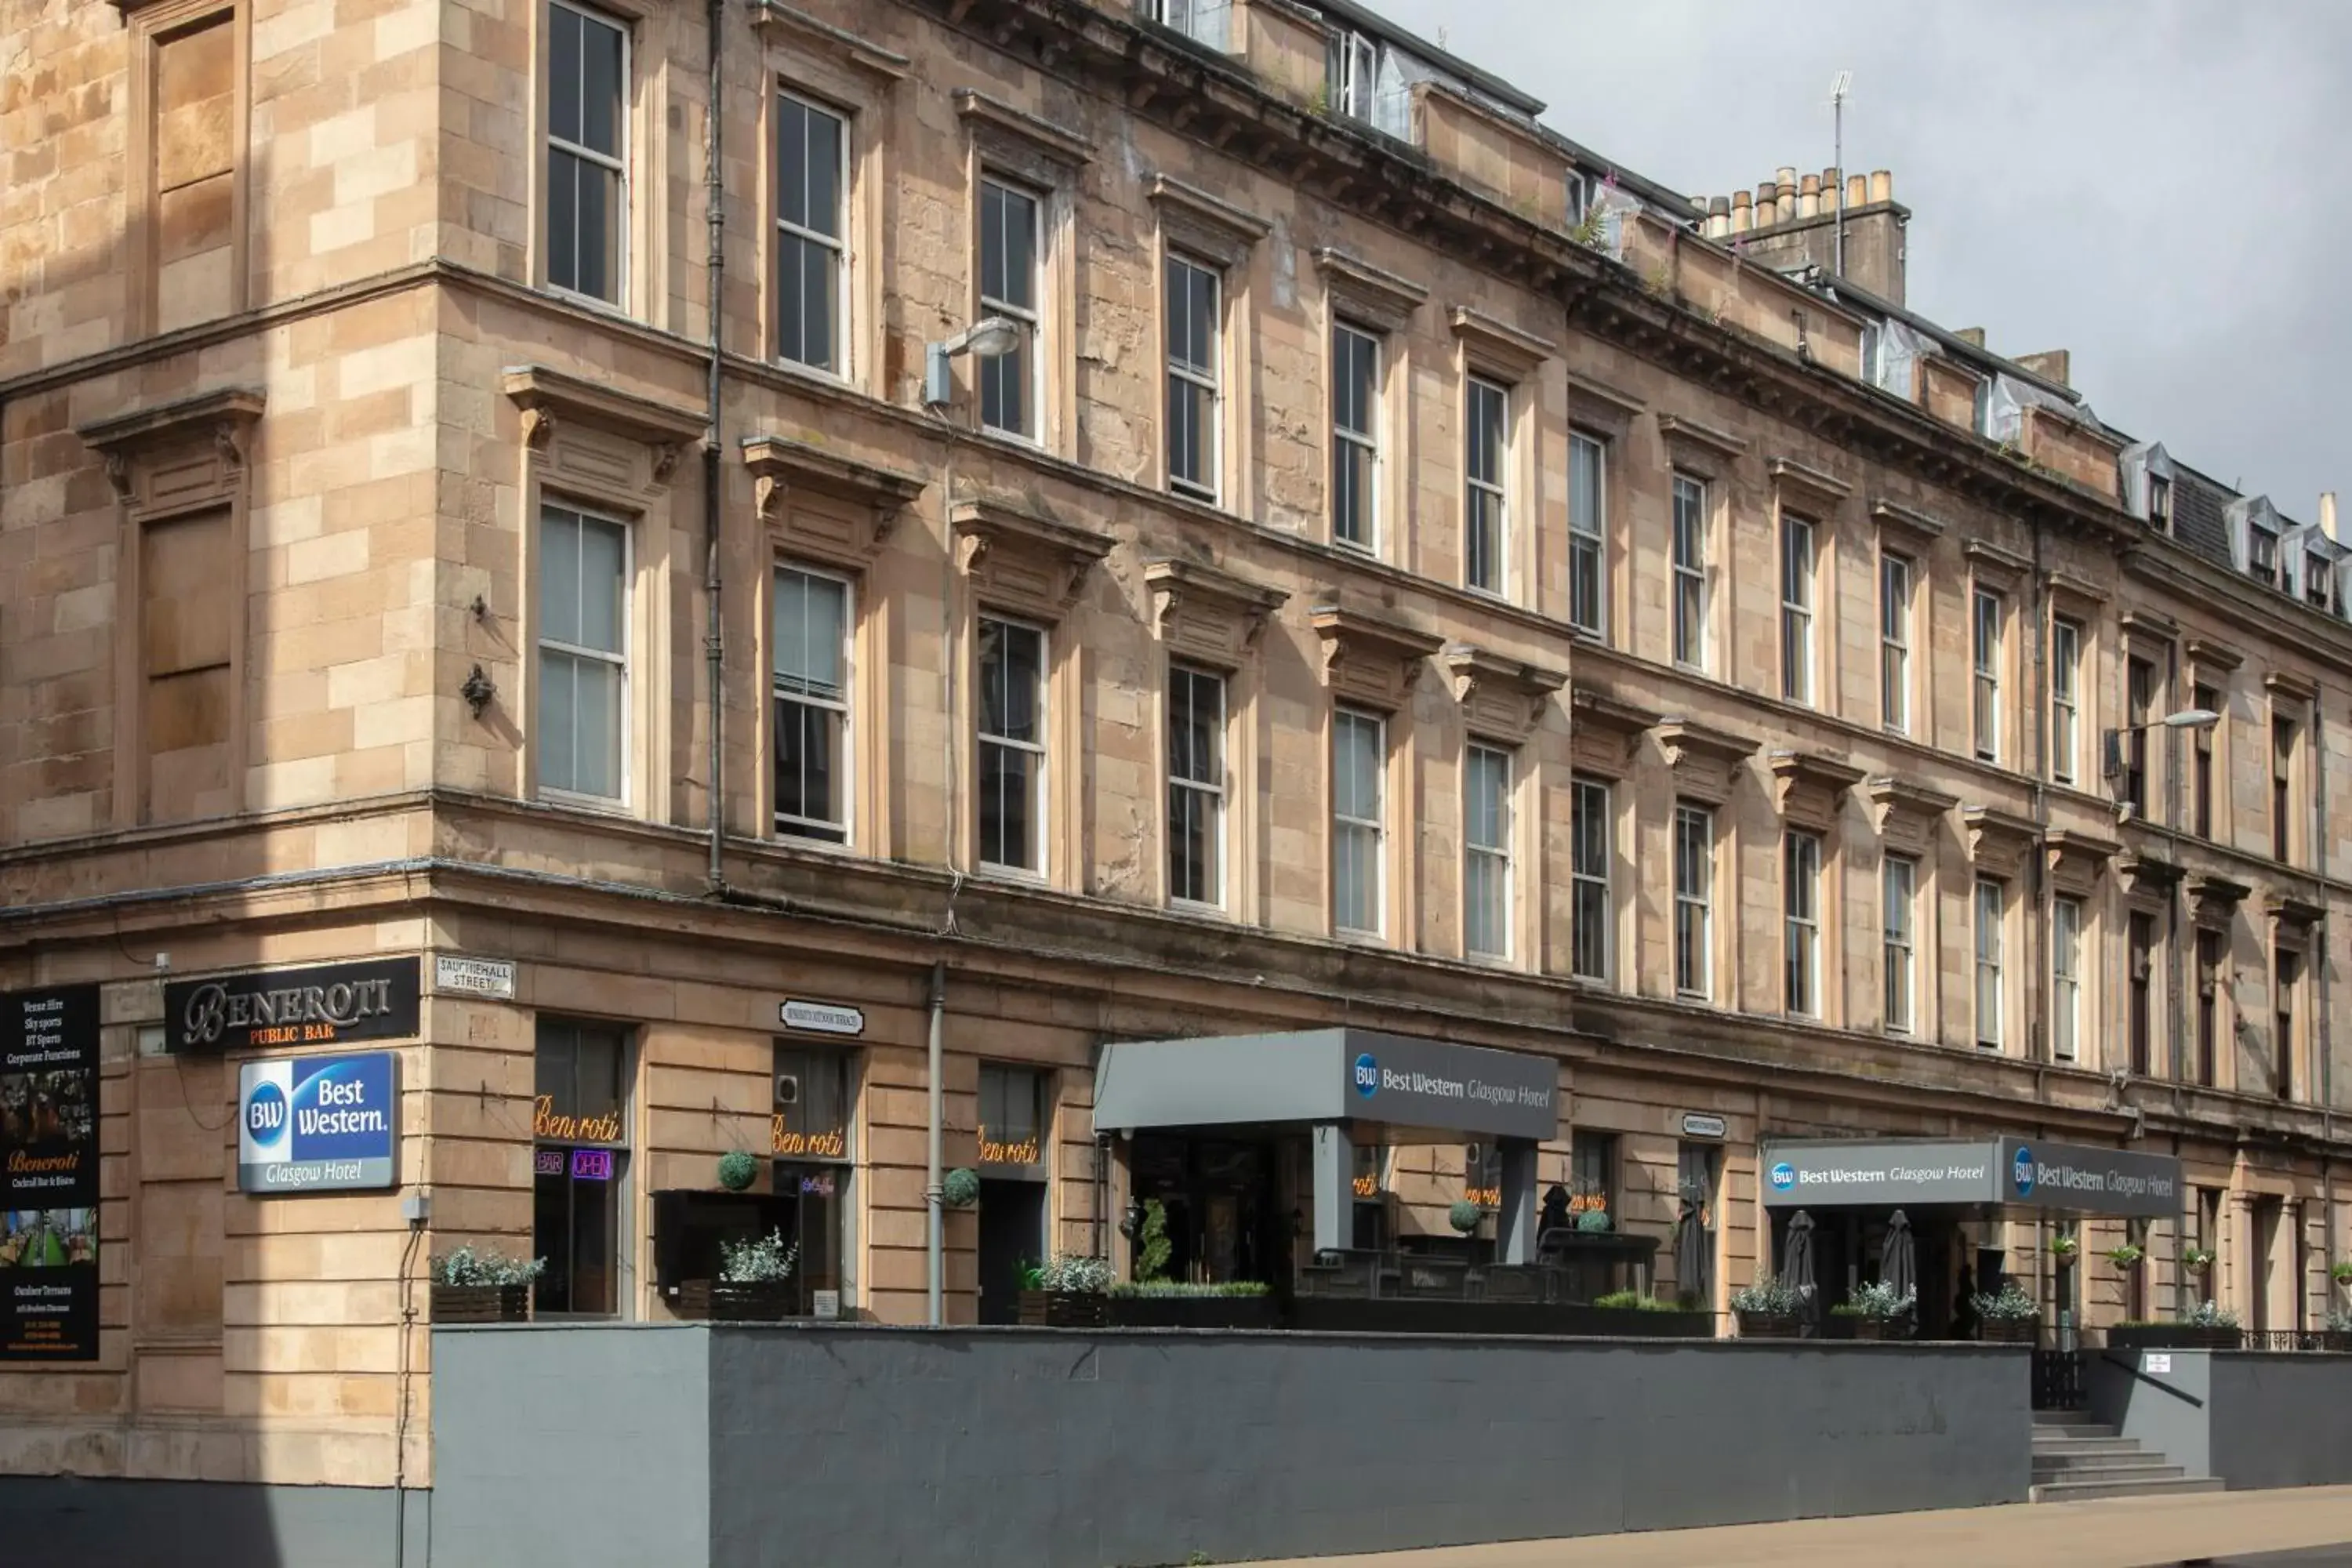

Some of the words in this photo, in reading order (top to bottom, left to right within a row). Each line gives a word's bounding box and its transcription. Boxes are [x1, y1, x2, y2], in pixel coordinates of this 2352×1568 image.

[454, 975, 491, 989] STREET
[182, 978, 391, 1044] BENEROTI
[24, 1018, 38, 1032] Sky
[250, 1026, 299, 1044] PUBLIC
[304, 1023, 335, 1041] BAR
[26, 1034, 36, 1046] BT
[319, 1079, 364, 1106] Best
[1356, 1066, 1376, 1085] BW
[1382, 1069, 1411, 1091] Best
[1413, 1073, 1464, 1098] Western
[1468, 1080, 1515, 1105] Glasgow
[1519, 1086, 1549, 1108] Hotel
[250, 1102, 284, 1129] BW
[7, 1149, 80, 1172] Beneroti
[576, 1153, 608, 1176] OPEN
[266, 1164, 321, 1185] Glasgow
[324, 1160, 362, 1181] Hotel
[1772, 1171, 1794, 1185] BW
[1799, 1171, 1828, 1183] Best
[1830, 1170, 1886, 1184] Western
[1889, 1167, 1944, 1185] Glasgow
[1947, 1164, 1985, 1181] Hotel
[2015, 1162, 2033, 1182] BW
[2038, 1162, 2060, 1187] Best
[2062, 1166, 2104, 1192] Western
[2107, 1170, 2147, 1198] Glasgow
[2147, 1176, 2173, 1198] Hotel
